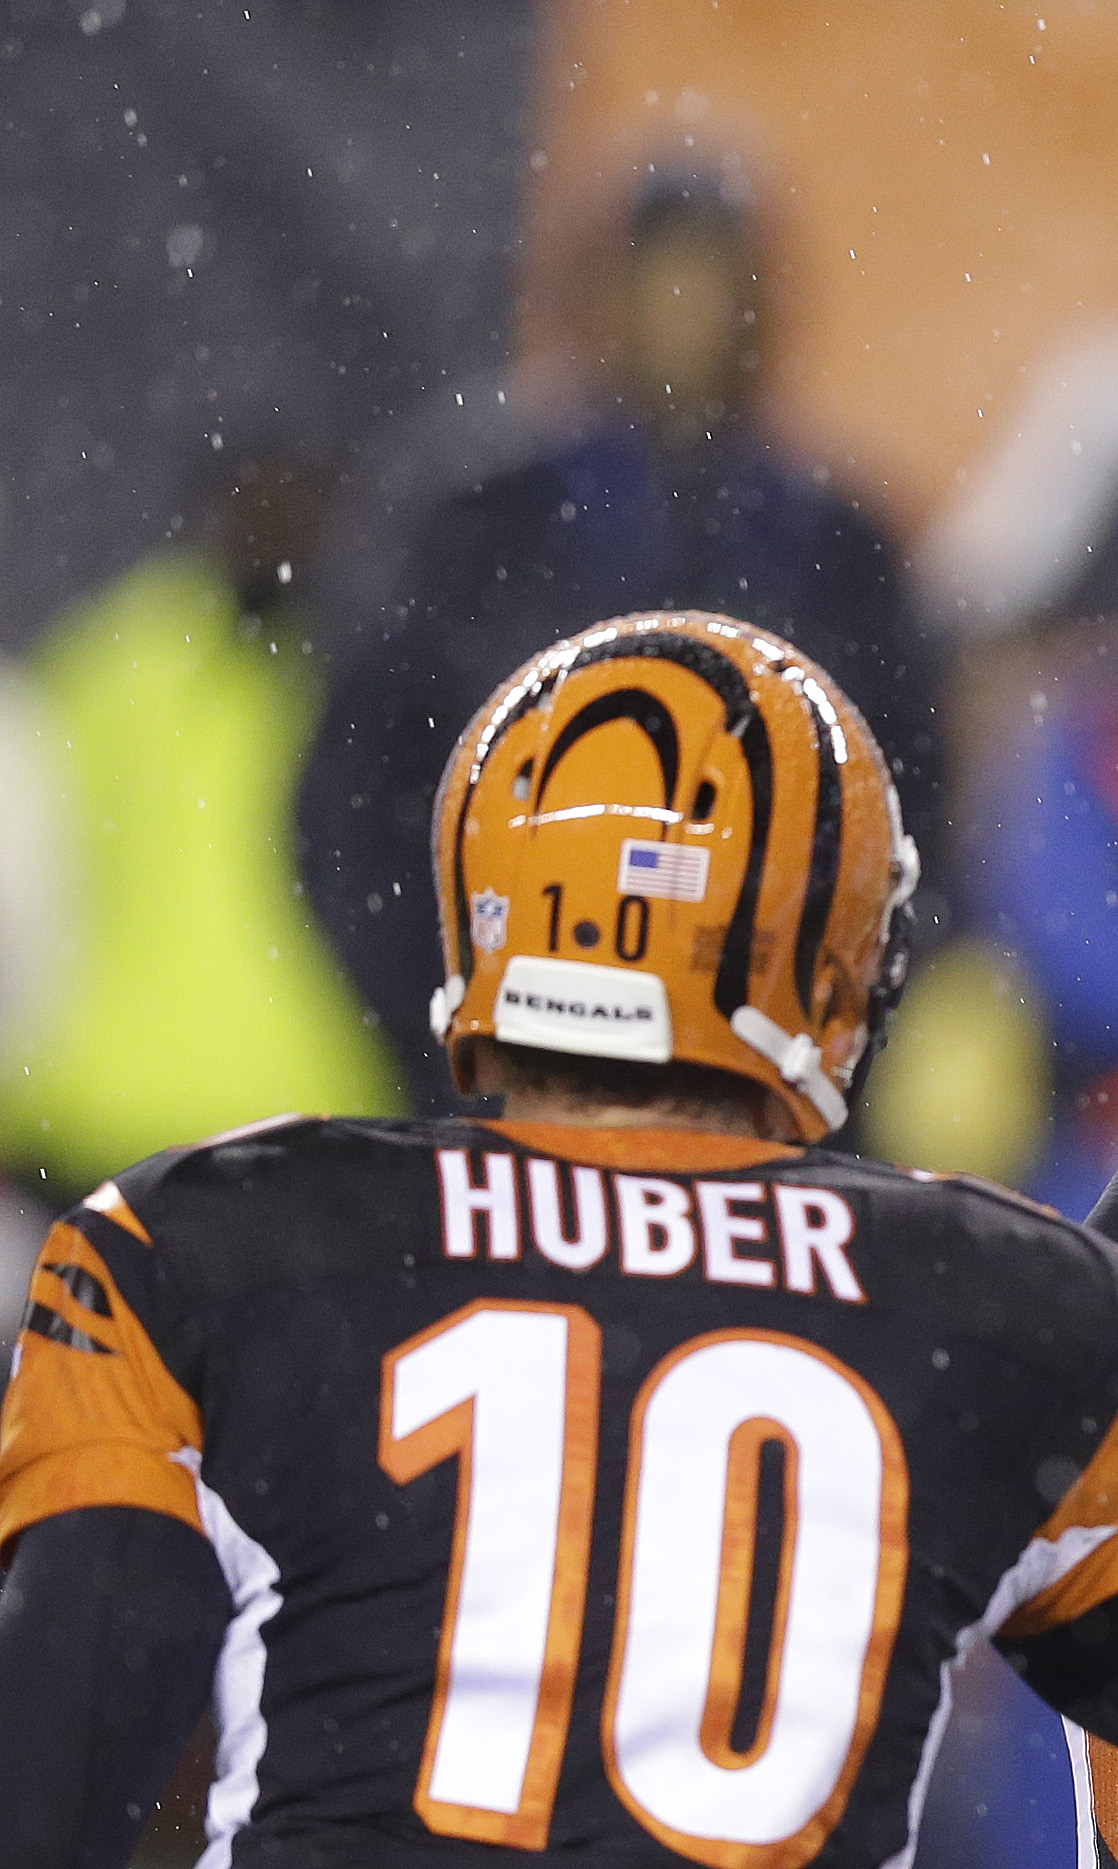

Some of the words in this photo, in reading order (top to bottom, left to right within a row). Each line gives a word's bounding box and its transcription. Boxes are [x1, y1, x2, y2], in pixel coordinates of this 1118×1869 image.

[505, 990, 653, 1021] BENGALS
[436, 1148, 868, 1304] HUBER
[378, 1297, 910, 1869] 10
